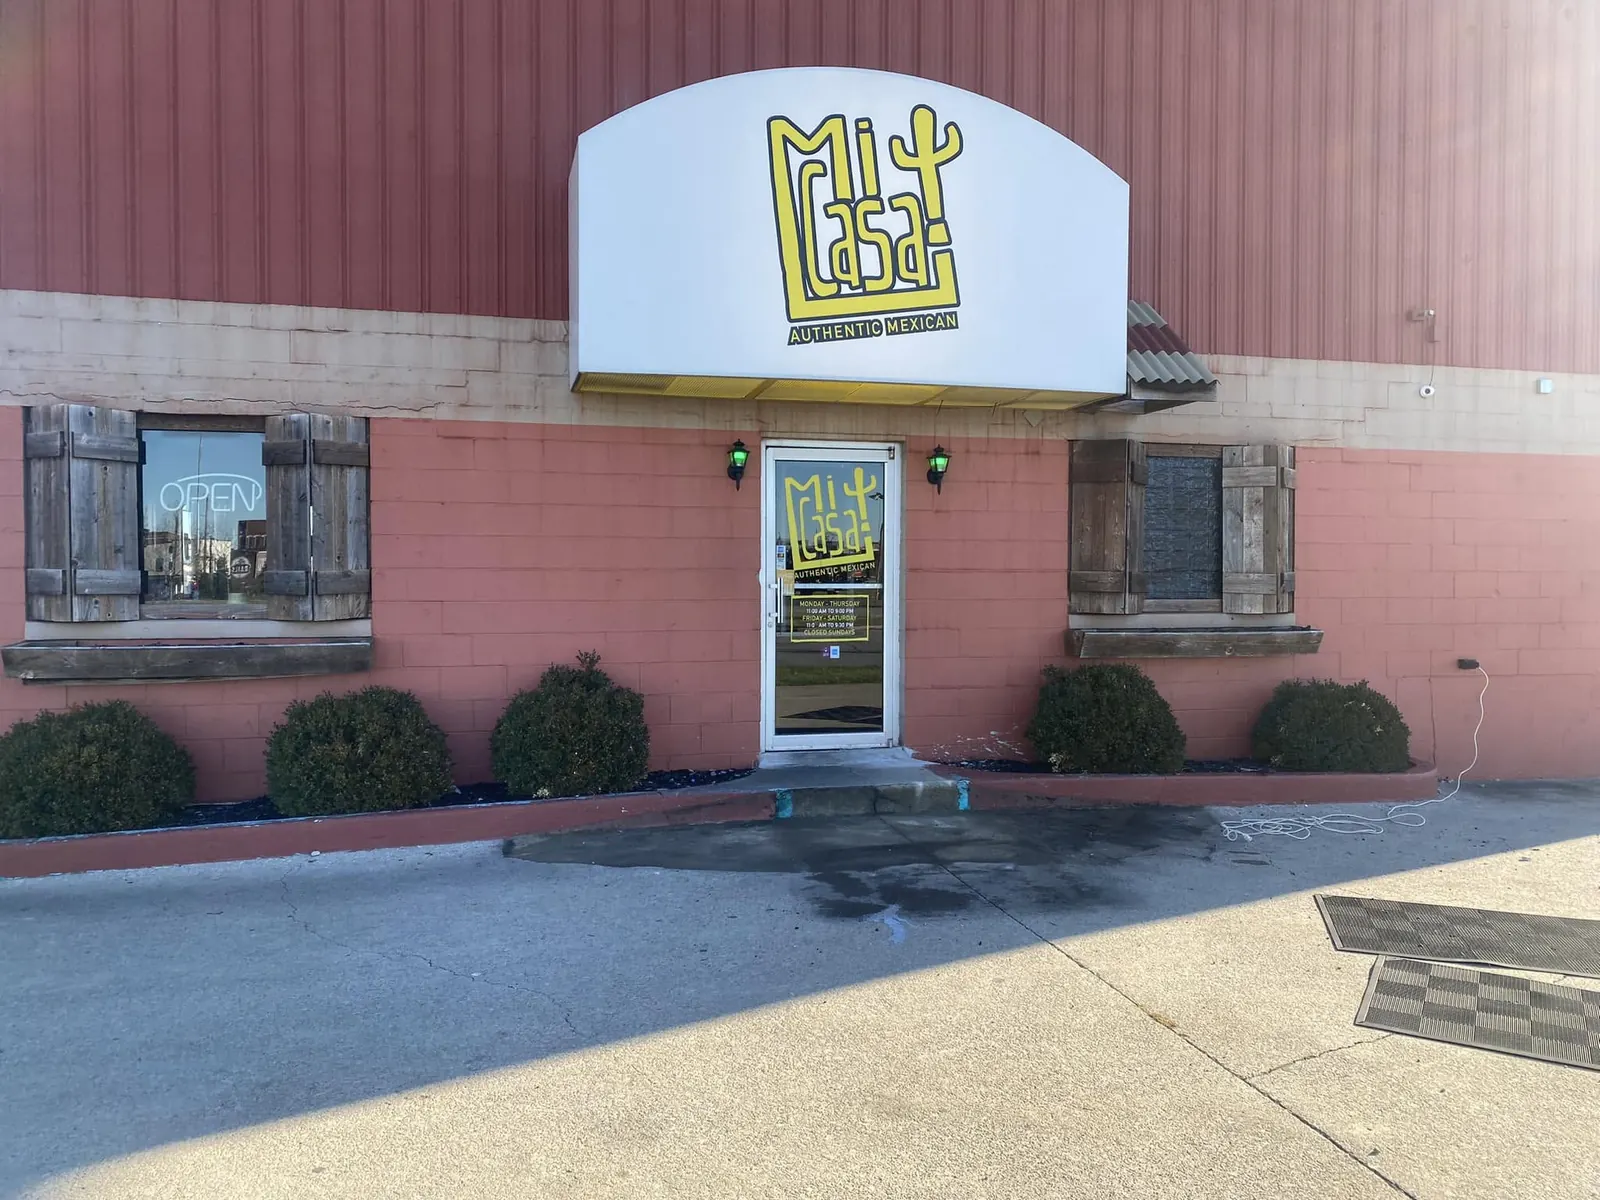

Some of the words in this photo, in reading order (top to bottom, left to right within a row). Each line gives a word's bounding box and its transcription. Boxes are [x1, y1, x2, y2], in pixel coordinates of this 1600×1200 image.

[788, 319, 883, 345] AUTHENTIC
[885, 312, 959, 336] MEXICAN
[160, 482, 256, 512] OPEN
[794, 567, 839, 579] AUTHENTIC
[840, 562, 876, 573] MEXICAN
